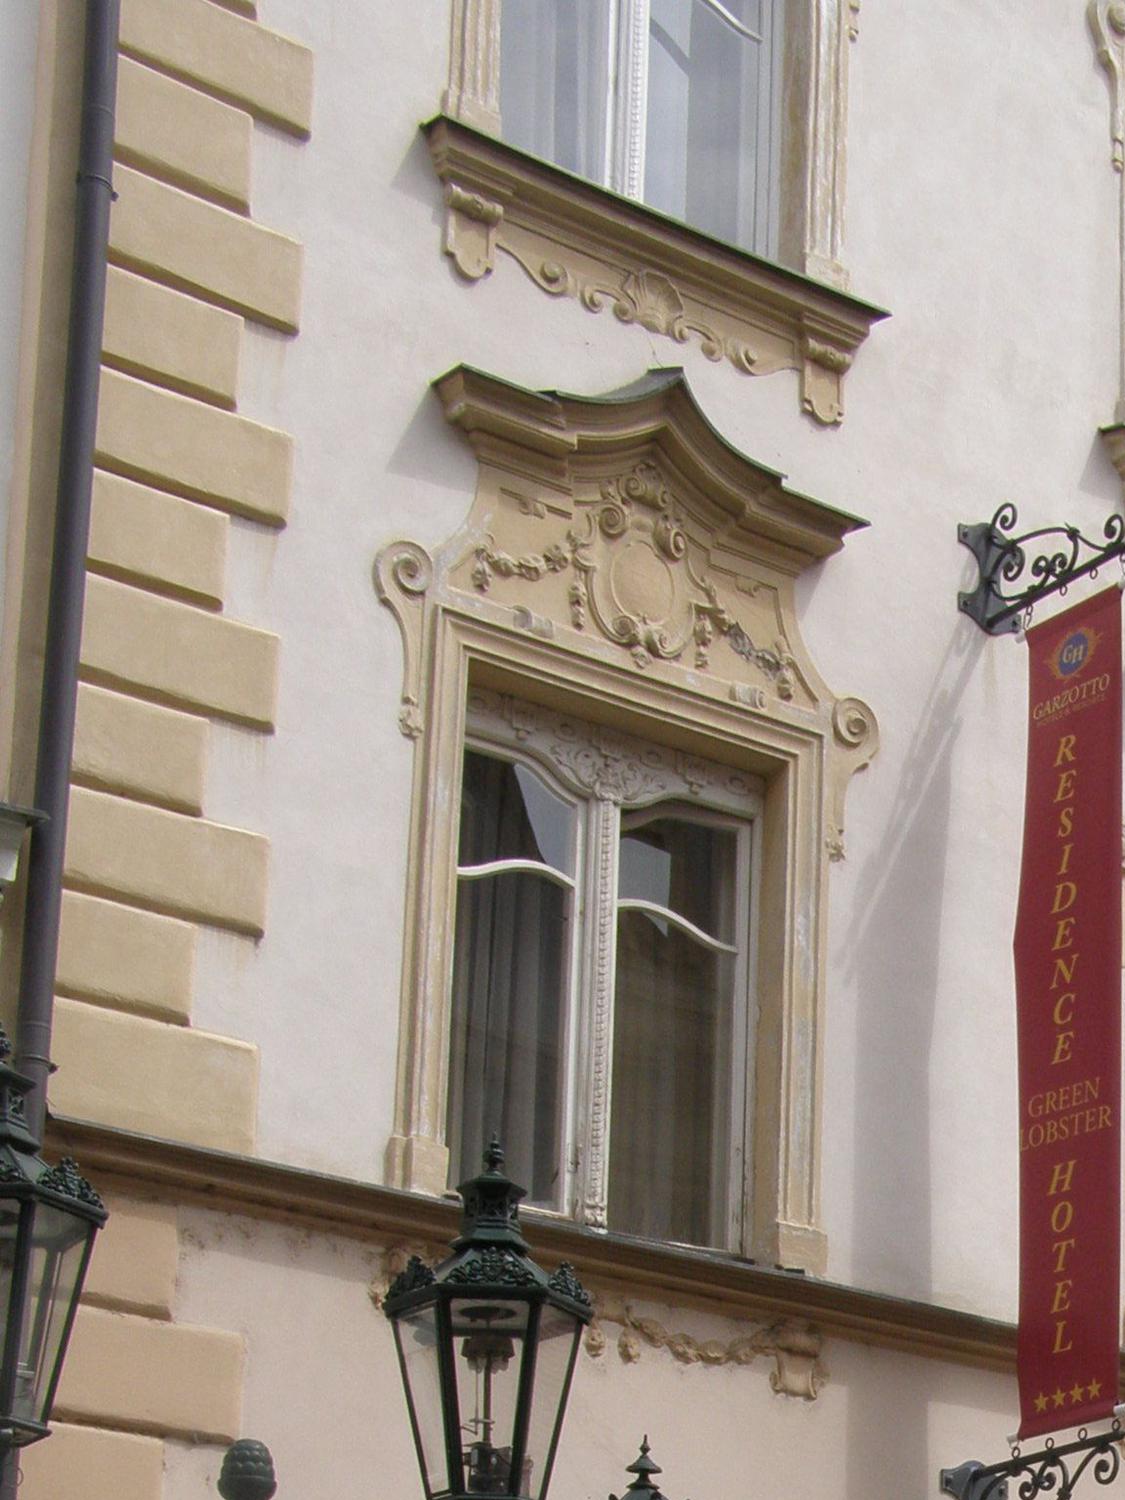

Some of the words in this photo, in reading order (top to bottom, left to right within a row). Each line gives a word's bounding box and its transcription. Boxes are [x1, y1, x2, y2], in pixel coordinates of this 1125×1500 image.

[1062, 643, 1084, 664] GH
[1032, 673, 1111, 720] GARZOTTO
[1051, 734, 1078, 1065] RESIDENCE
[1027, 1077, 1101, 1118] GREEN
[1020, 1105, 1112, 1151] LOBSTER
[1047, 1160, 1077, 1354] HOTEL
